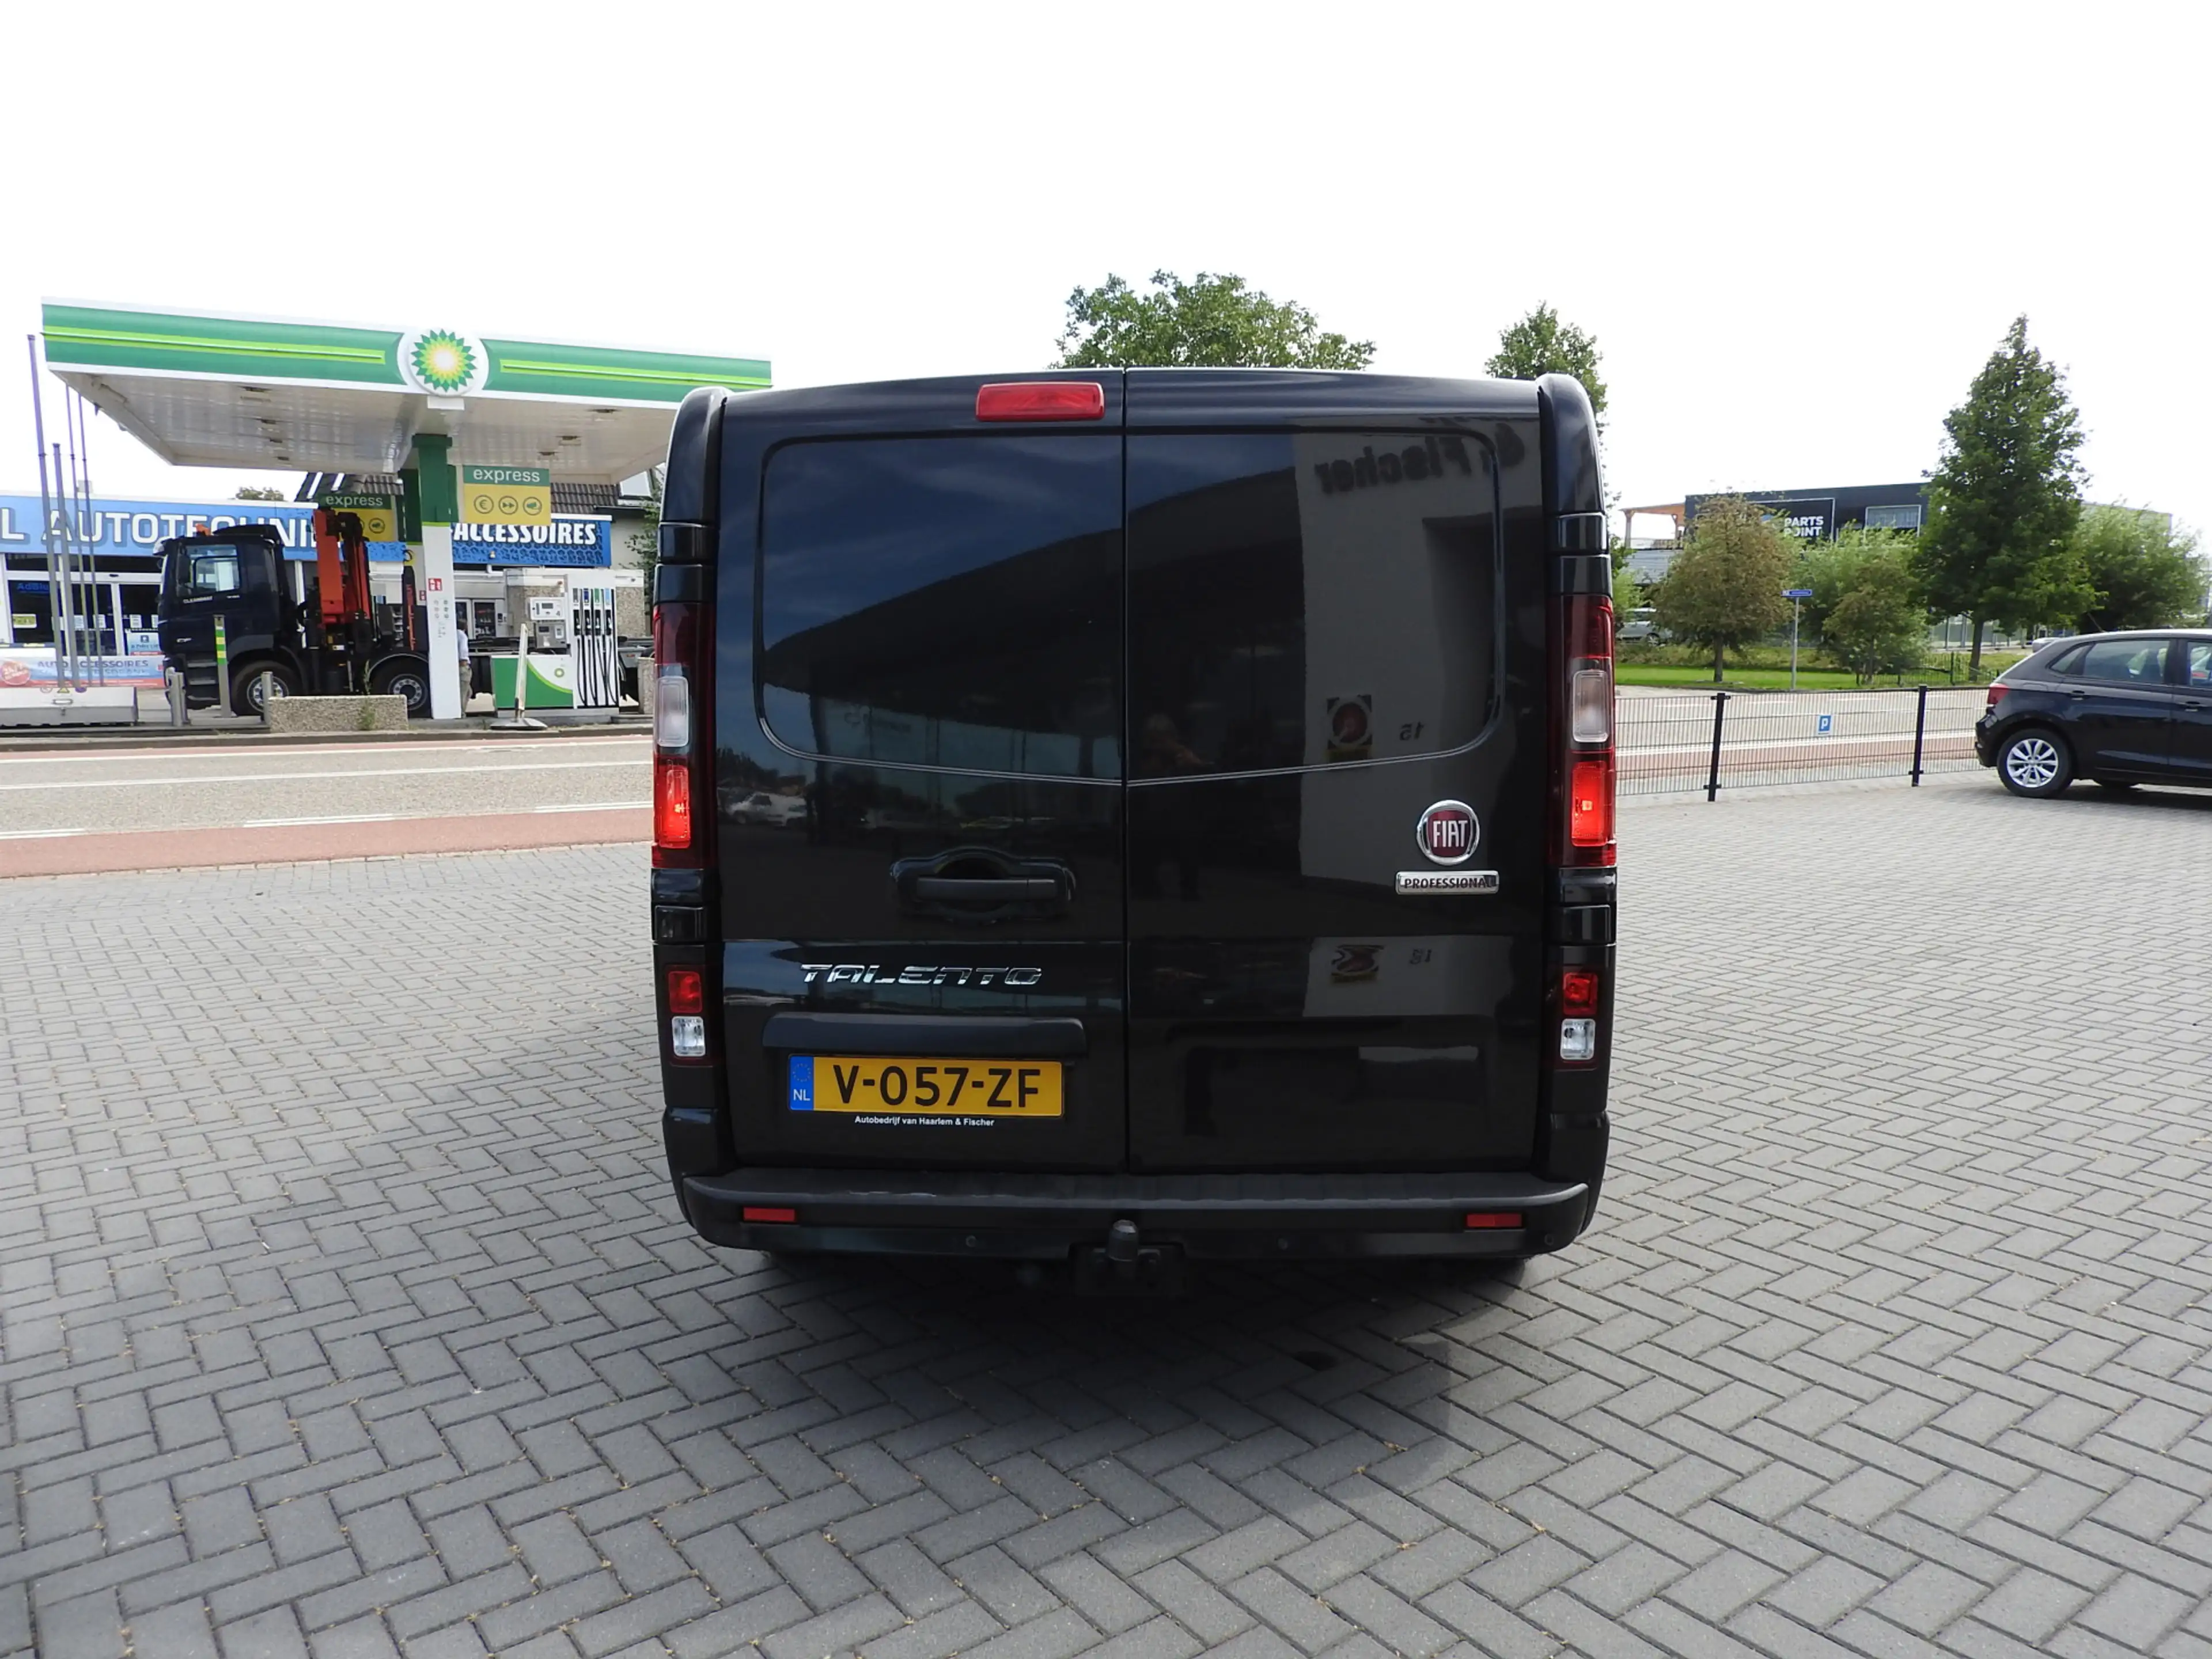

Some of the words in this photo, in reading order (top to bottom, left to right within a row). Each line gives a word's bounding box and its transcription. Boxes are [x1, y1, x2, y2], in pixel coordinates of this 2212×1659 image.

[473, 468, 540, 484] express
[326, 495, 383, 507] express
[1784, 516, 1823, 527] PARTS
[41, 510, 341, 548] AUTOTENI
[453, 522, 596, 544] ACCESSOIRES
[1784, 527, 1822, 536] POINT
[1433, 820, 1468, 847] FIAT
[1404, 877, 1497, 889] PROFESSIONAL
[801, 964, 1041, 984] TALENTO
[833, 1065, 1041, 1107] V-057-ZF
[793, 1089, 810, 1101] NL
[855, 1115, 900, 1126] Autobedrijf
[919, 1116, 953, 1125] Haarlem
[963, 1118, 995, 1126] Fischer
